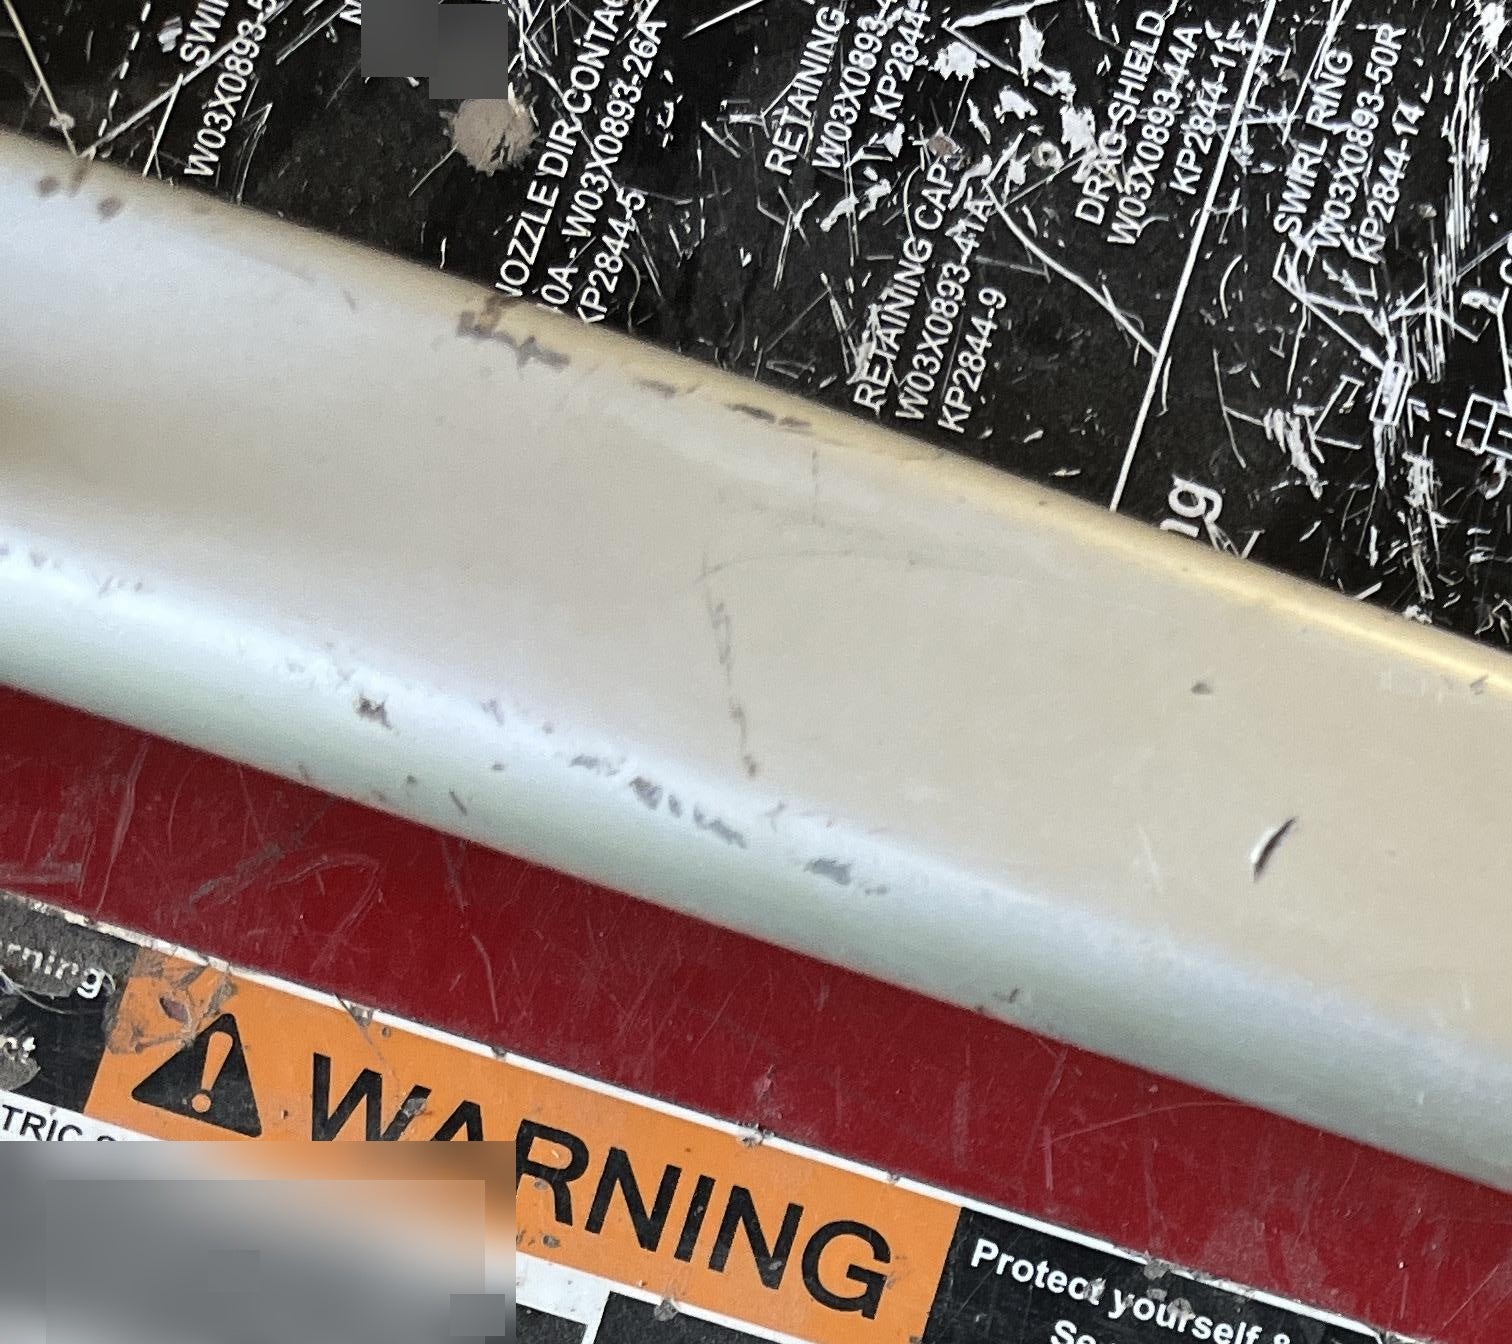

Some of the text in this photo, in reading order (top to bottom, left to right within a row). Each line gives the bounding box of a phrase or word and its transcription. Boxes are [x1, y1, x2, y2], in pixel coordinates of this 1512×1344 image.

[537, 113, 584, 178] DIR
[561, 10, 668, 245] W03X0893-26A
[764, 6, 847, 176] RETAINING
[1074, 10, 1171, 225] DRAG SHIELD
[1106, 26, 1211, 245] W03X0893-44A
[1164, 33, 1249, 195] KP2844-11
[1273, 42, 1353, 241] SWIRL RING
[1304, 22, 1415, 248] W03X0893-50R
[1347, 98, 1425, 264] KP2844-14
[572, 186, 646, 331] KP2844-5
[853, 160, 960, 415] RETAINING CAP
[895, 190, 1000, 419] W03X0893-41A
[937, 287, 1007, 434] KP2844-9
[970, 1238, 1107, 1306] Protect
